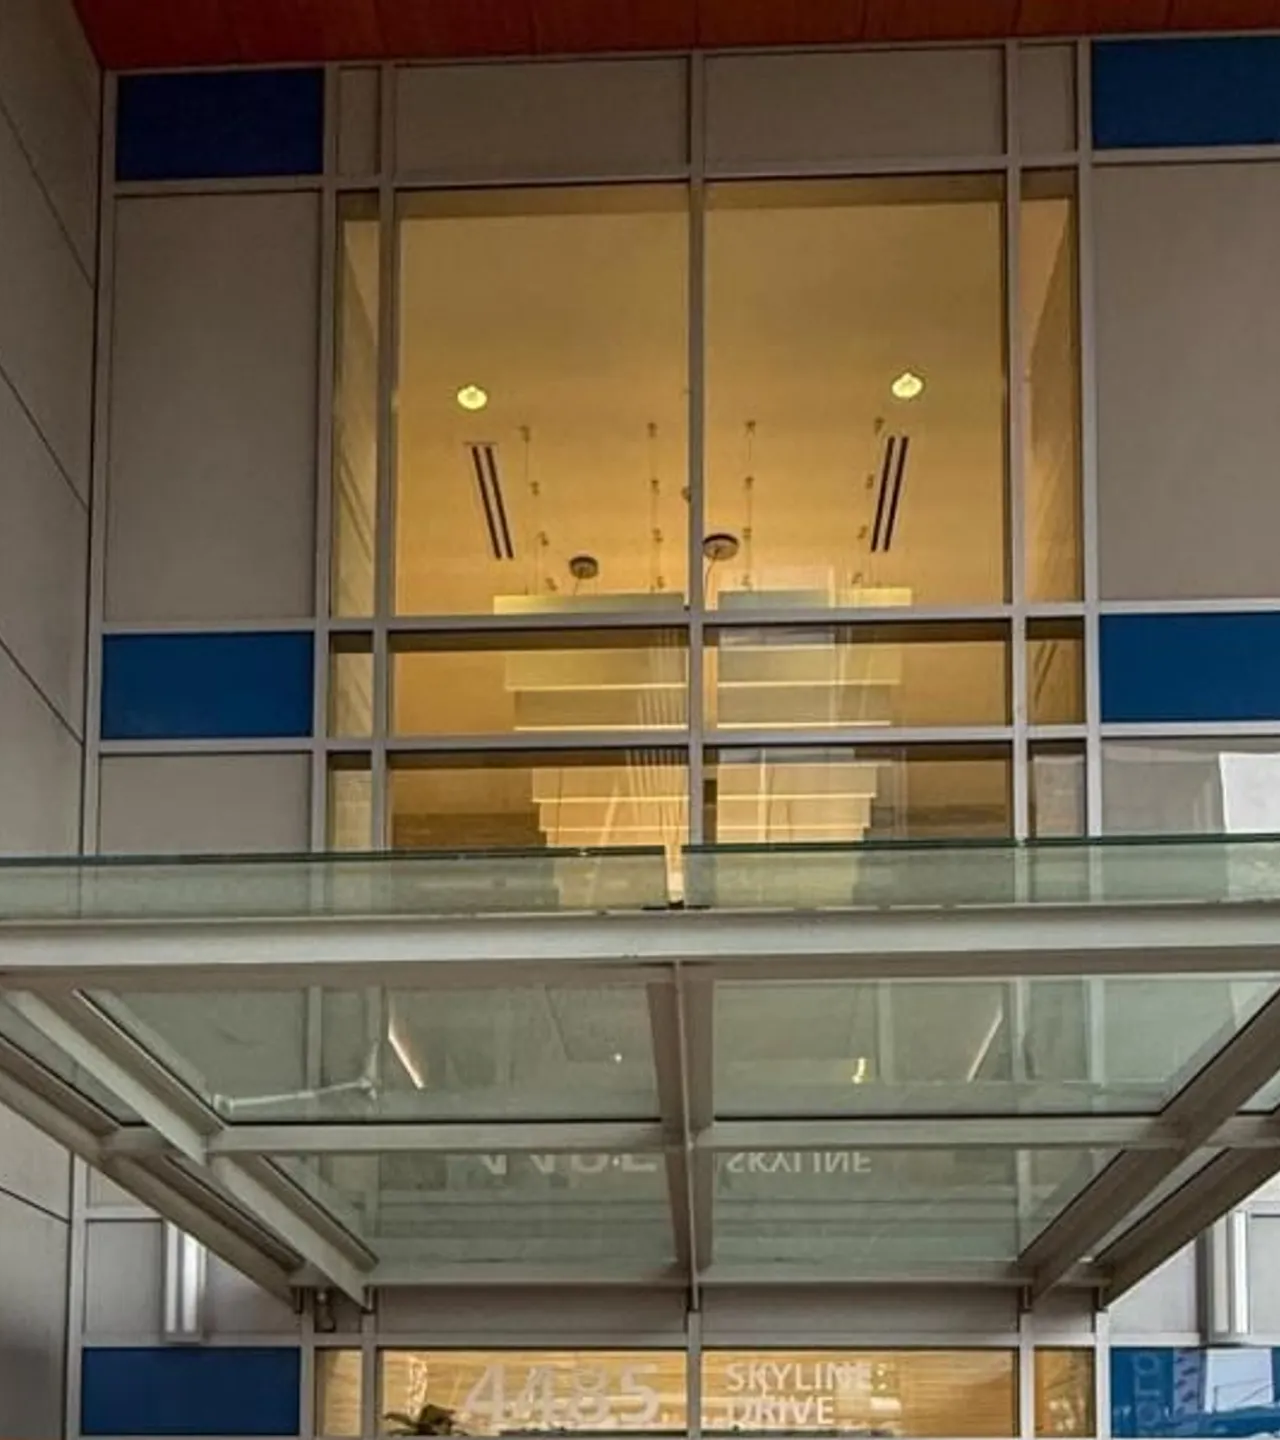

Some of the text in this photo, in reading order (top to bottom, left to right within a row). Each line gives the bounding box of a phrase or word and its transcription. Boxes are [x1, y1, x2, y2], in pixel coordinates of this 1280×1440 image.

[726, 1362, 872, 1391] SKYLINE
[463, 1364, 660, 1425] 4485
[726, 1396, 834, 1424] DRIVE
